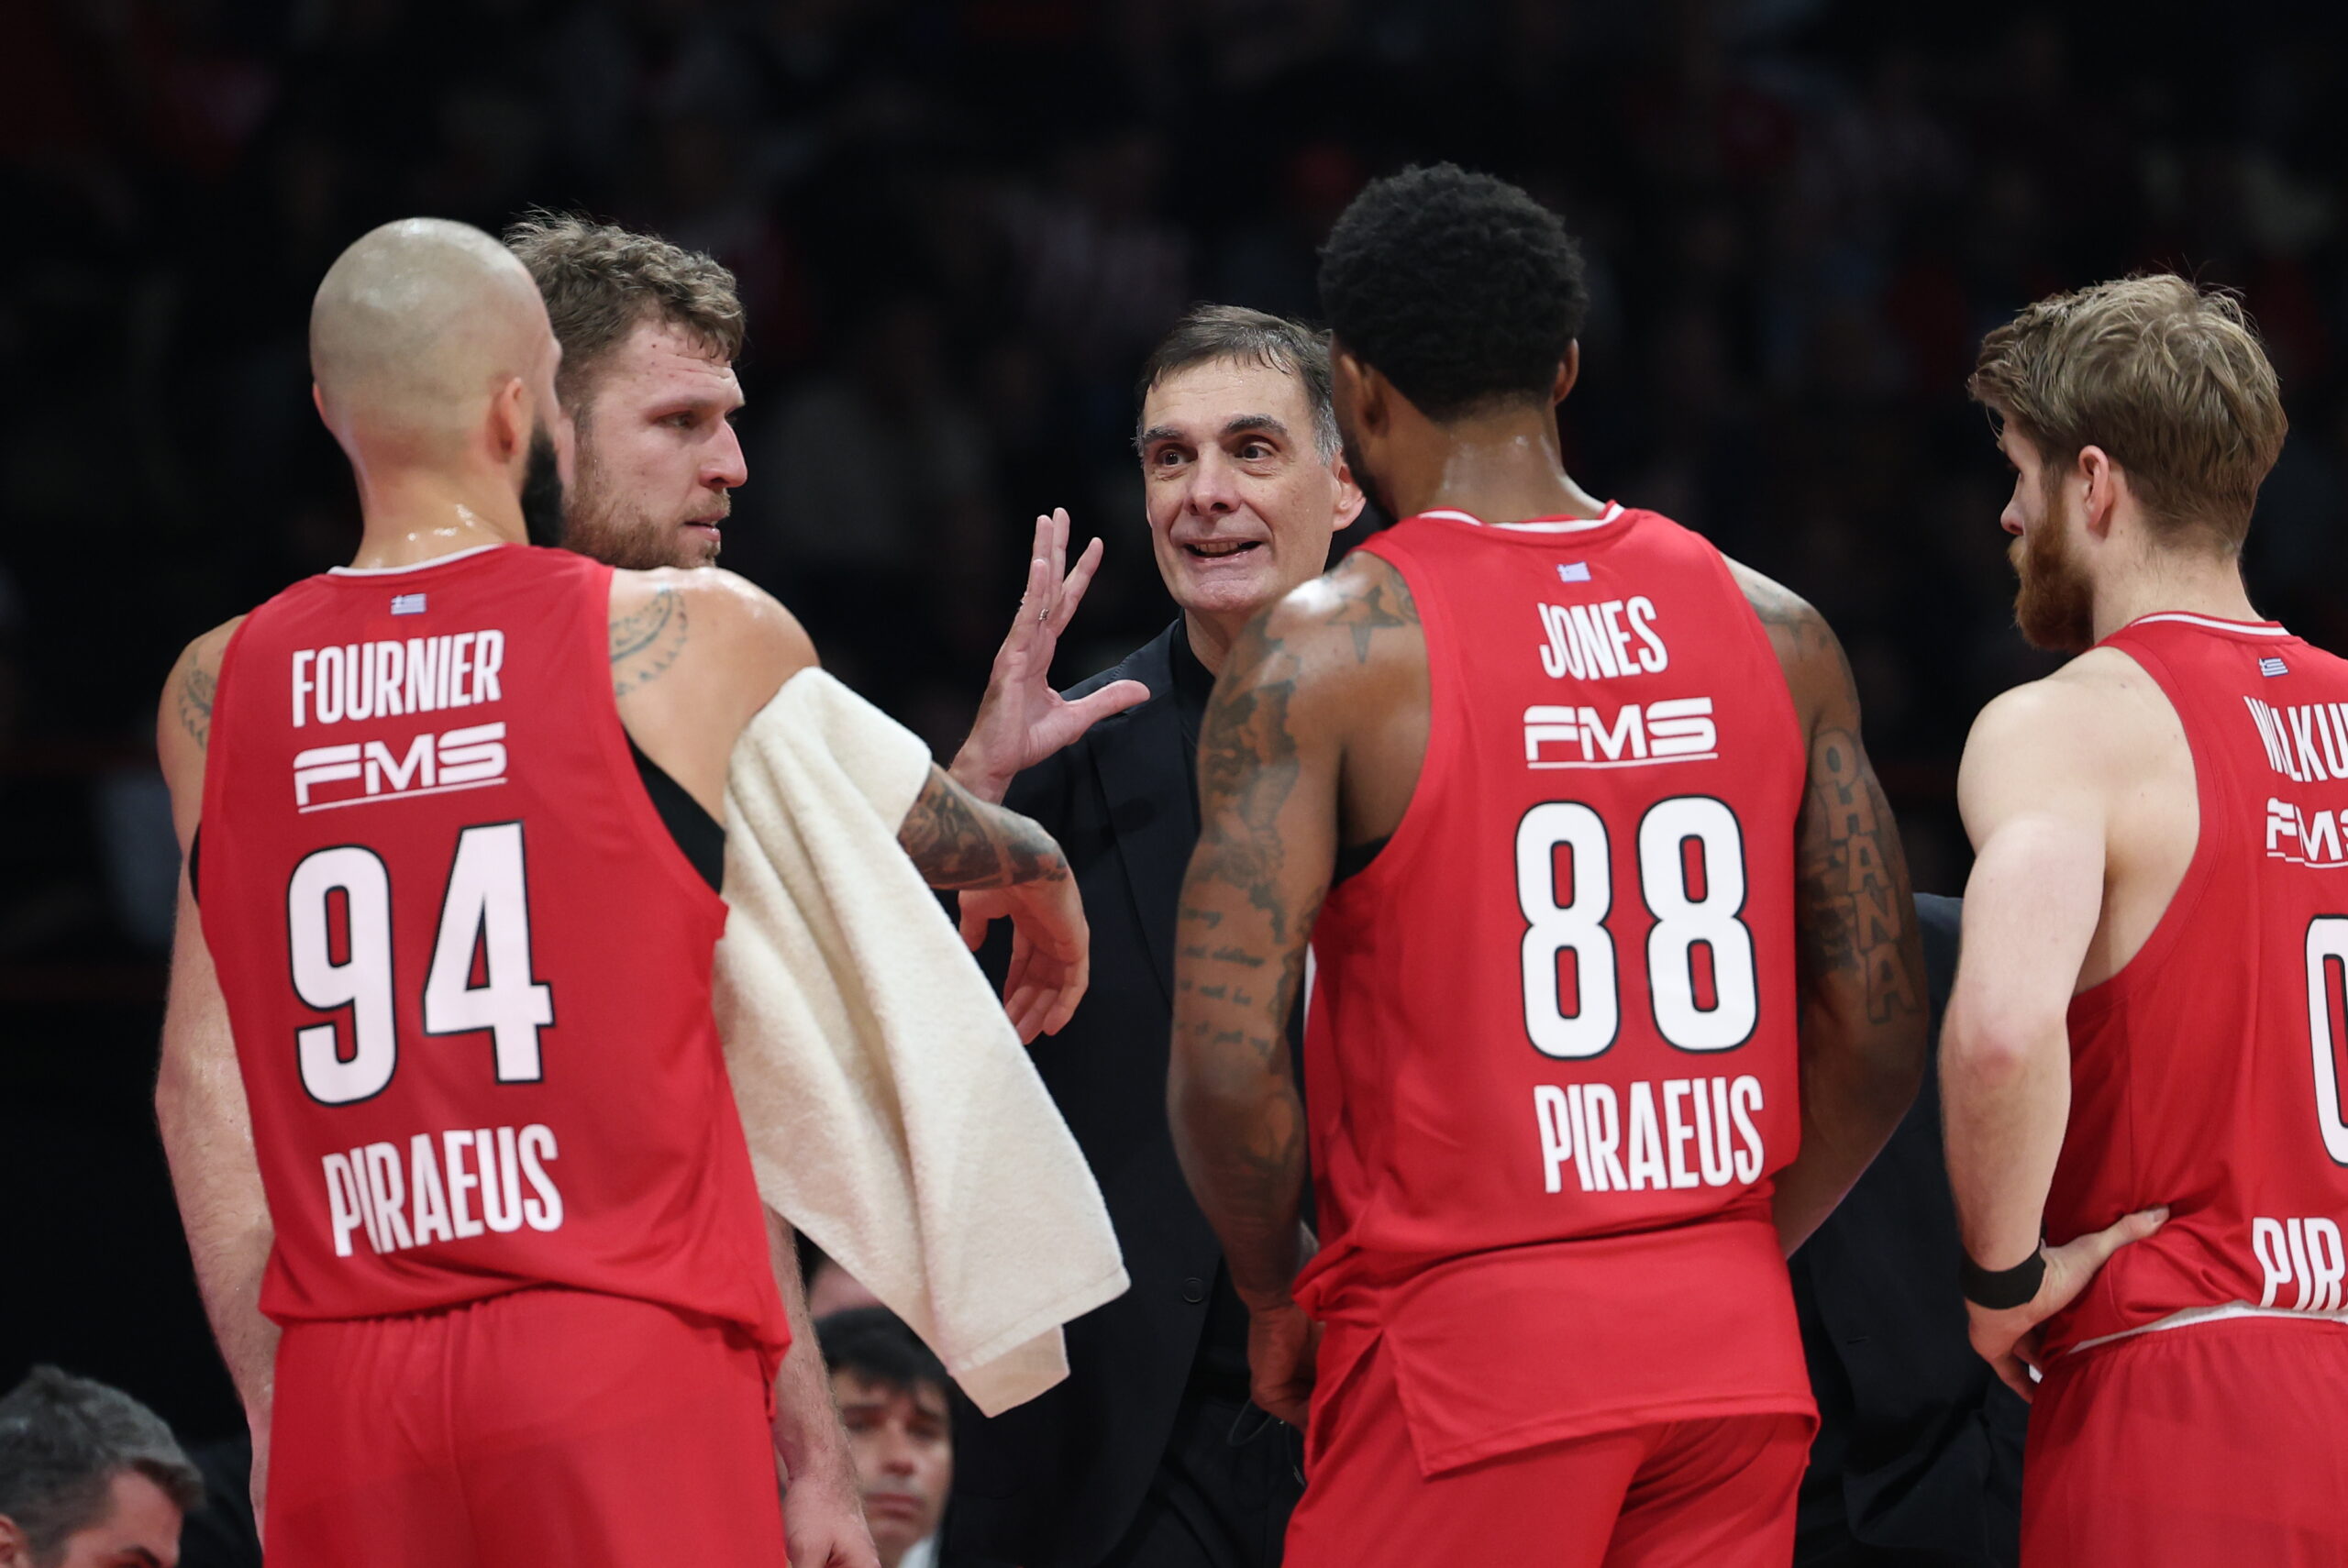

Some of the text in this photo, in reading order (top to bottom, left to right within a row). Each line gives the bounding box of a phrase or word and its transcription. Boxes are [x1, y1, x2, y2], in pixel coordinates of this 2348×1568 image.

[293, 630, 504, 727] FOURNIER
[1538, 596, 1668, 680] JONES
[294, 722, 507, 807] FMS
[1523, 697, 1718, 763] FMS
[2243, 695, 2348, 782] WLKU
[1811, 730, 1918, 1023] OHANA
[2265, 797, 2348, 862] FM
[287, 820, 555, 1106] 94
[1514, 795, 1760, 1060] 88
[1534, 1075, 1765, 1193] PIRAEUS
[322, 1124, 563, 1257] PIRAEUS
[2252, 1217, 2348, 1311] PIR
